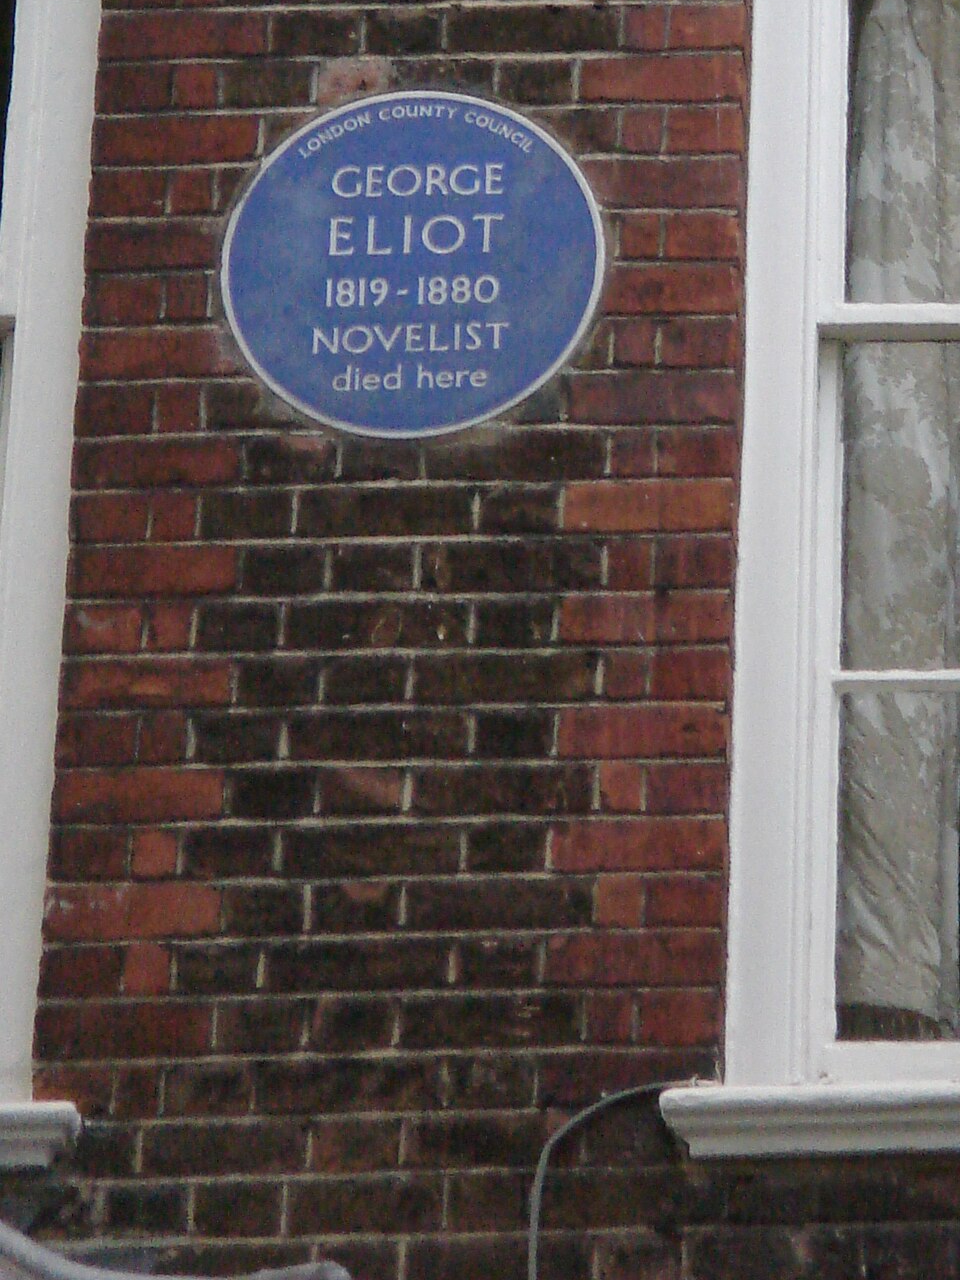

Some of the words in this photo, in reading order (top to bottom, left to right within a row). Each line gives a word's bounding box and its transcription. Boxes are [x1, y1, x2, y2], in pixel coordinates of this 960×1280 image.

[298, 111, 371, 159] LONDON
[379, 104, 458, 120] COUNTY
[464, 111, 536, 153] COUNCIL
[331, 163, 505, 199] GEORGE
[328, 212, 505, 257] ELIOT
[311, 322, 511, 356] NOVELIST
[332, 364, 402, 393] died
[417, 364, 488, 389] here
